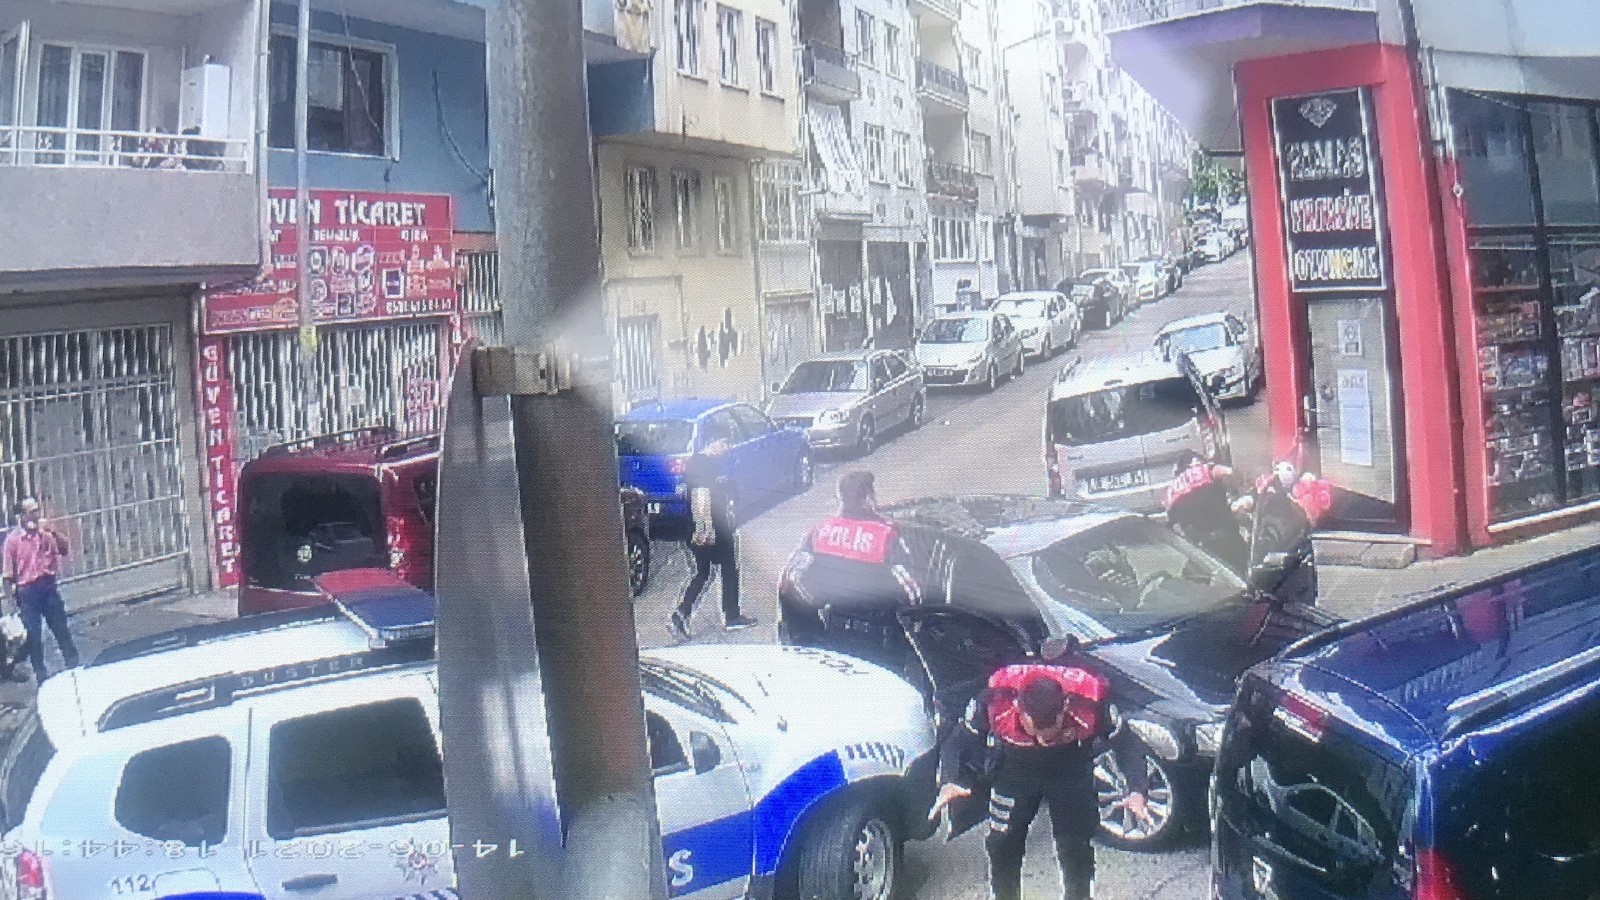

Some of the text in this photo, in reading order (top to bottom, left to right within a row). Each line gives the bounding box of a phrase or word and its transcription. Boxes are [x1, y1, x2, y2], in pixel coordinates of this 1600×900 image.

[334, 194, 425, 226] TİCARET
[203, 345, 236, 573] GÜVEN TİCARET
[240, 657, 364, 688] DUSTER
[111, 874, 151, 894] 112
